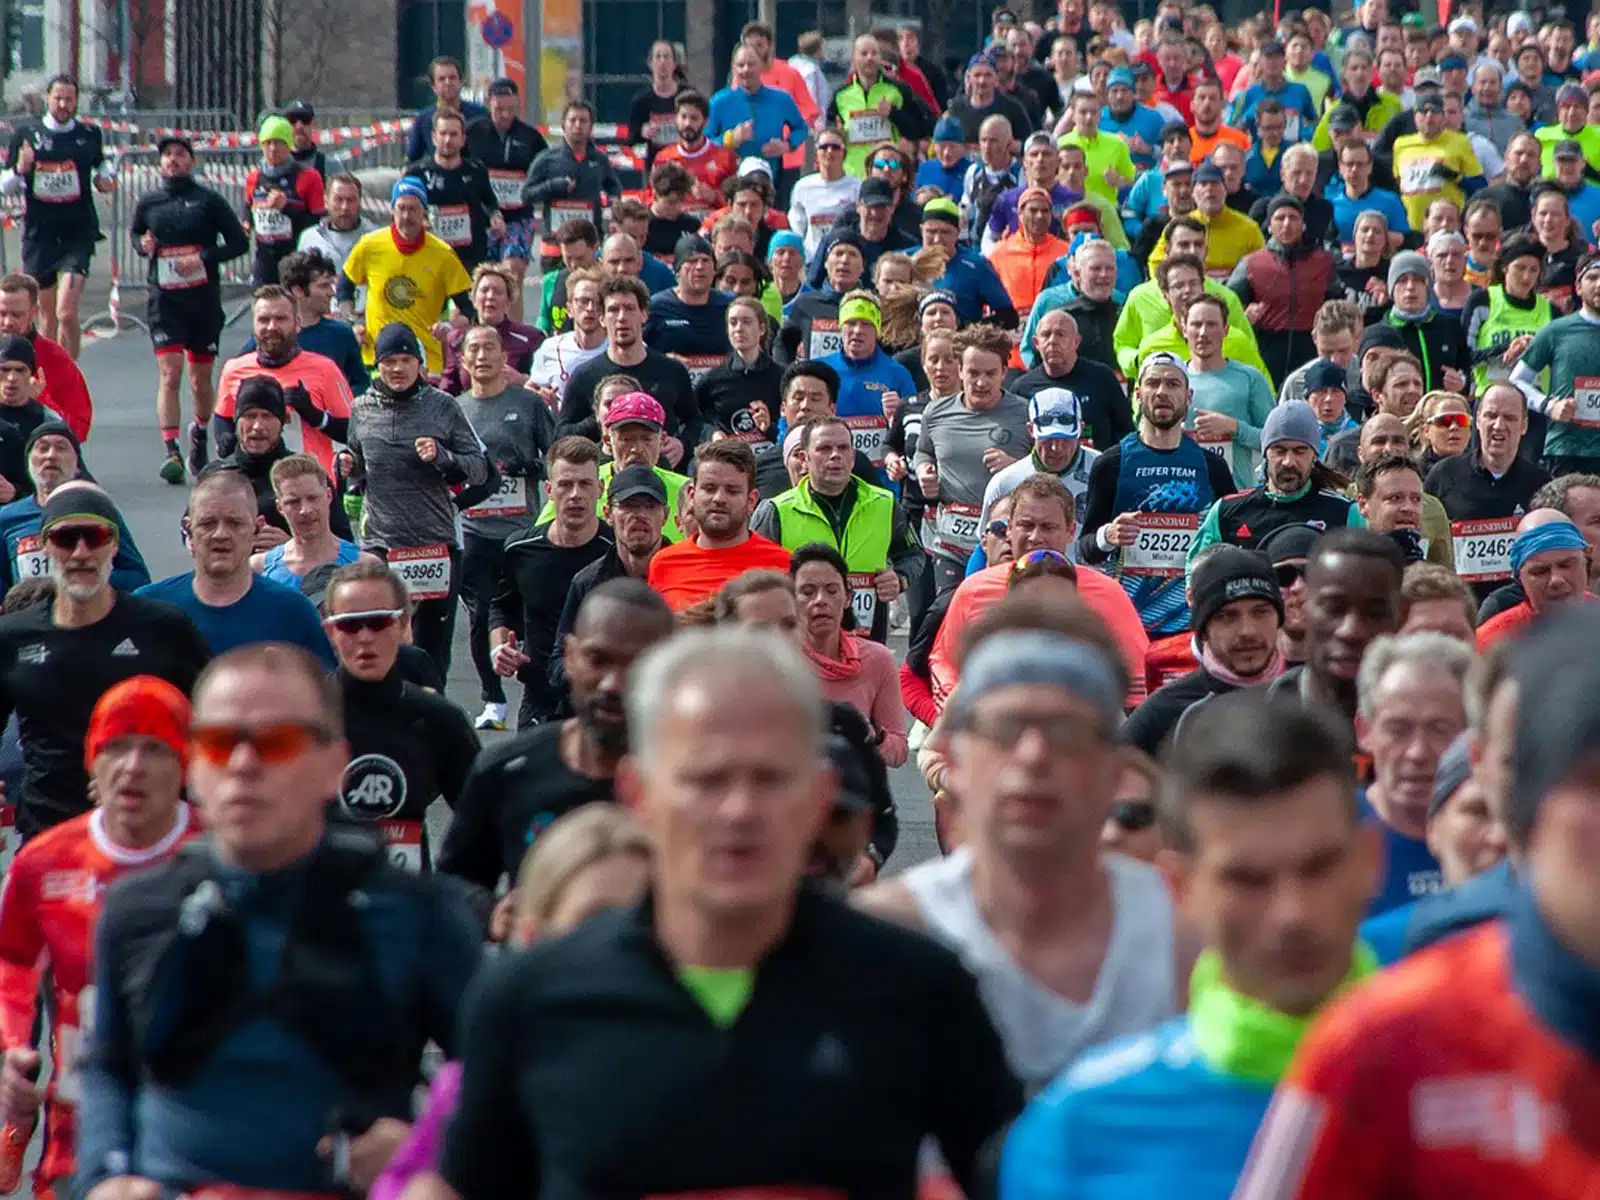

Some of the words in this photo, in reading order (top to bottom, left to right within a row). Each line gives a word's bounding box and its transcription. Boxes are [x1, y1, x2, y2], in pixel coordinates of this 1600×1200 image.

[854, 432, 880, 449] 866
[1135, 466, 1169, 478] FEIFER
[1170, 466, 1197, 478] TEAM
[952, 519, 979, 537] 527
[1148, 517, 1190, 527] GENERALI
[1473, 521, 1513, 532] GENERALI
[1139, 532, 1191, 552] 52522
[31, 557, 49, 576] 31
[402, 562, 444, 580] 53965
[1225, 578, 1250, 592] RUN
[1252, 578, 1272, 591] NYC
[855, 593, 873, 611] 10
